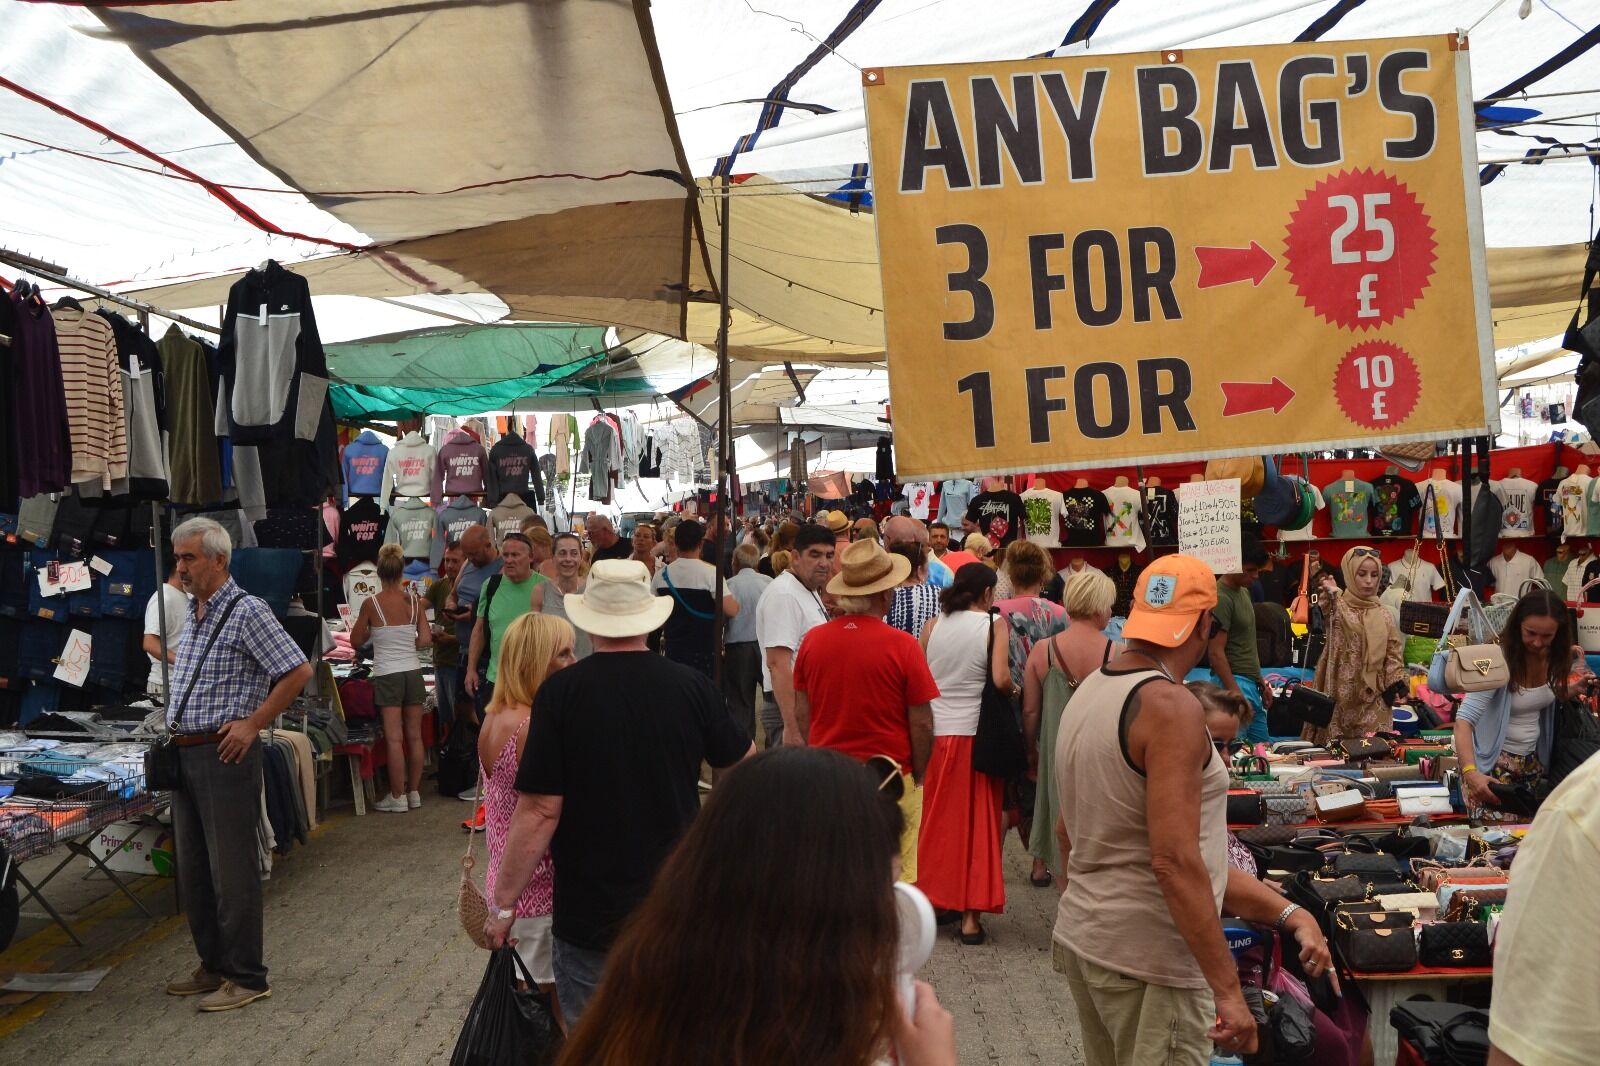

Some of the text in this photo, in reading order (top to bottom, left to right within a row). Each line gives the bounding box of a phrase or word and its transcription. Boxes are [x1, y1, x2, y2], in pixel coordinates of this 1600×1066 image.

[900, 50, 1438, 193] ANY BAG'S
[1327, 192, 1395, 264] 25
[935, 224, 1183, 341] 3 FOR
[1356, 274, 1381, 318] £
[1353, 355, 1395, 389] 10
[957, 357, 1198, 448] 1 FOR
[1371, 392, 1389, 420] £
[449, 456, 479, 467] WHITE
[455, 466, 474, 477] FOX
[351, 522, 379, 533] WHITE
[401, 520, 429, 532] WHITE
[499, 520, 521, 530] WHIT
[356, 532, 375, 542] FOX
[406, 530, 425, 541] FOX
[1210, 537, 1230, 546] EURO
